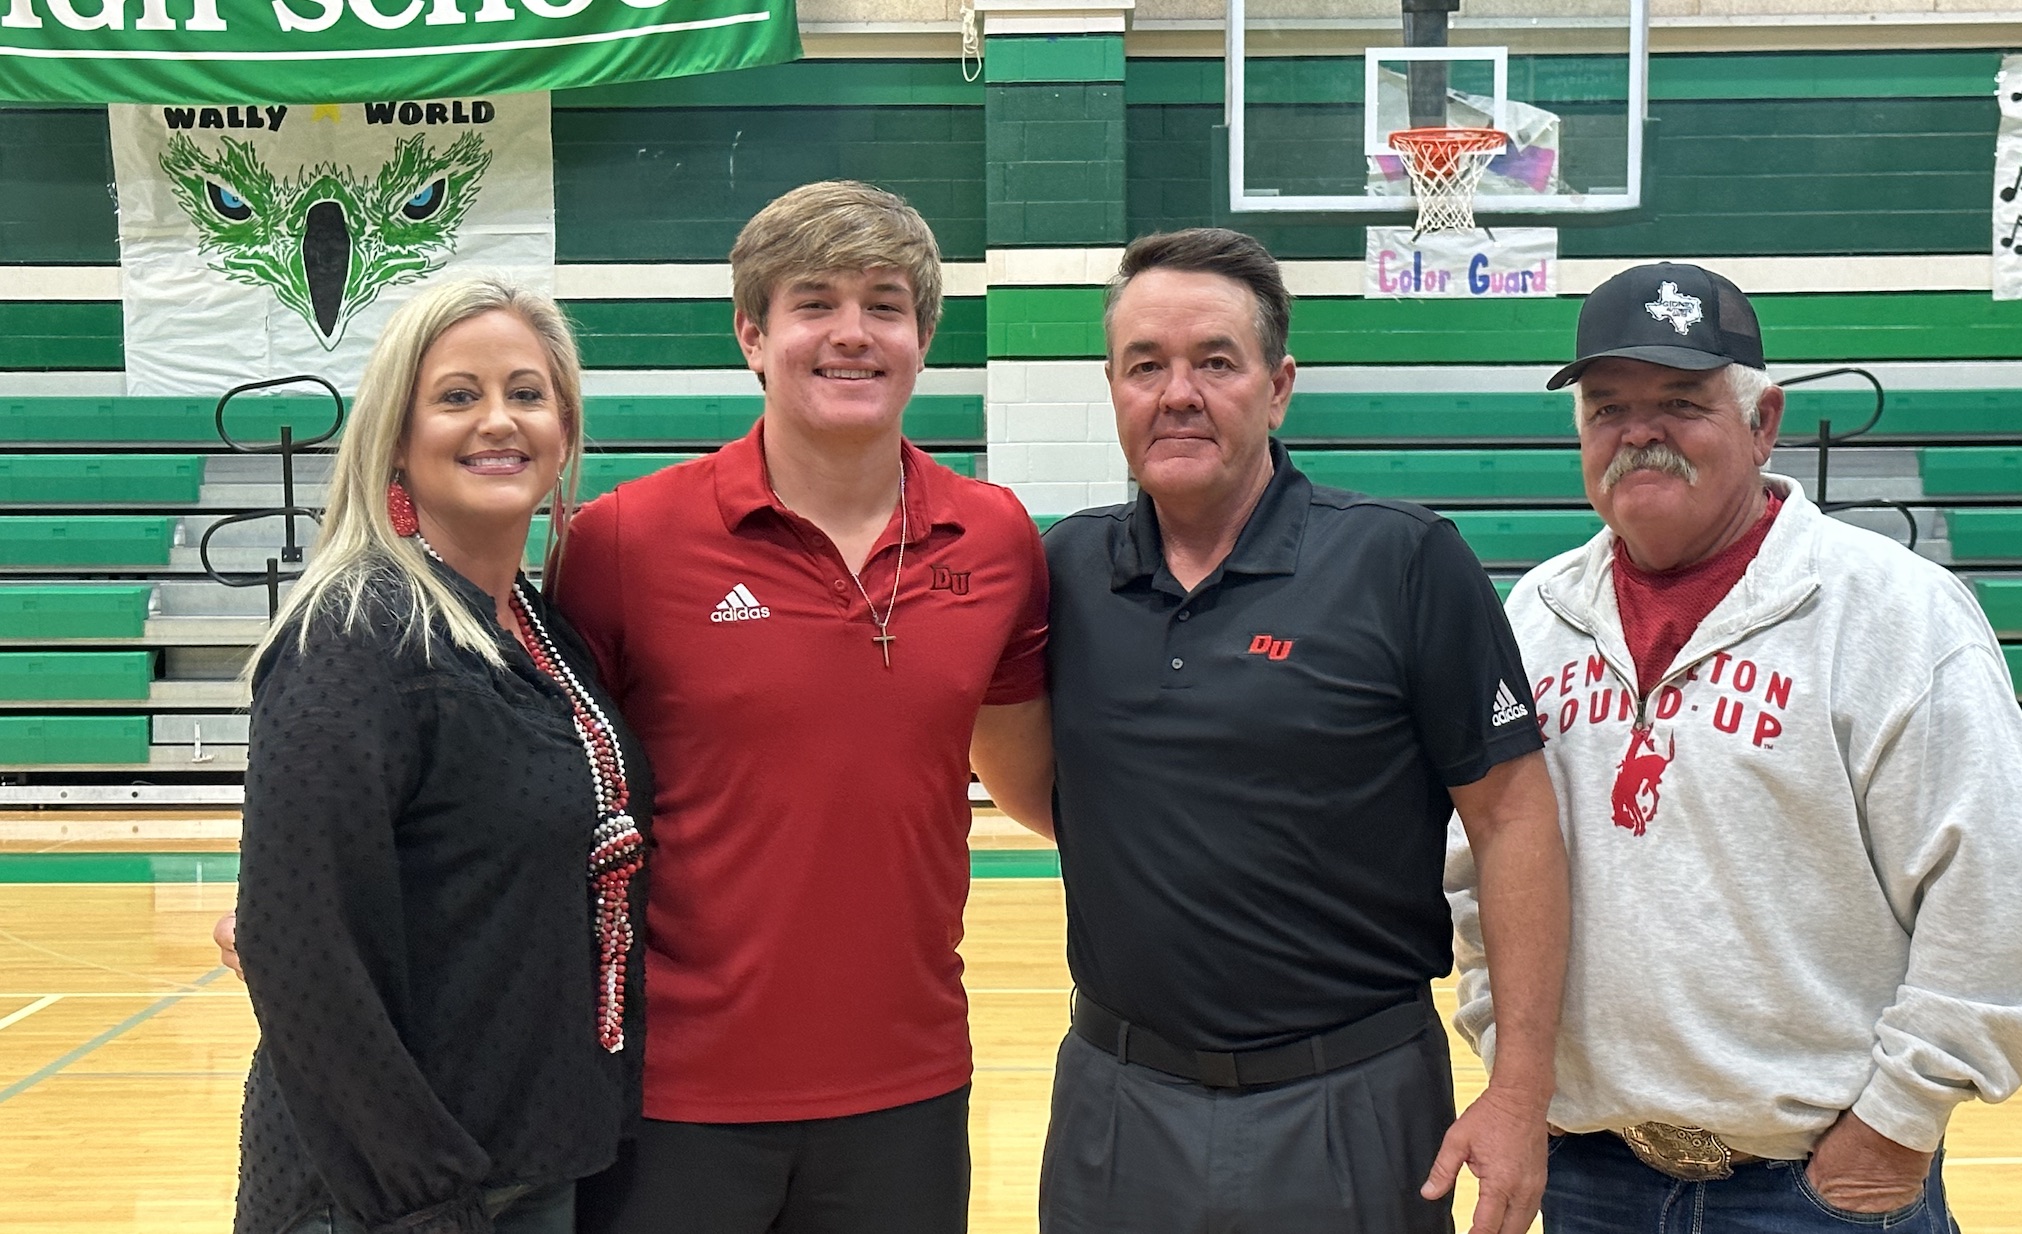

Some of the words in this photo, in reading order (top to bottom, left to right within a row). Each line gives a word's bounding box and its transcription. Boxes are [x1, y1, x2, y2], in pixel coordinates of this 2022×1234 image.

[163, 105, 288, 131] WALLY
[364, 100, 495, 125] WORLD
[1379, 250, 1451, 293] Color
[1468, 253, 1547, 295] Guard
[929, 564, 972, 596] DU
[710, 606, 771, 622] adidas
[1247, 633, 1294, 661] DU
[1492, 703, 1528, 727] adidas
